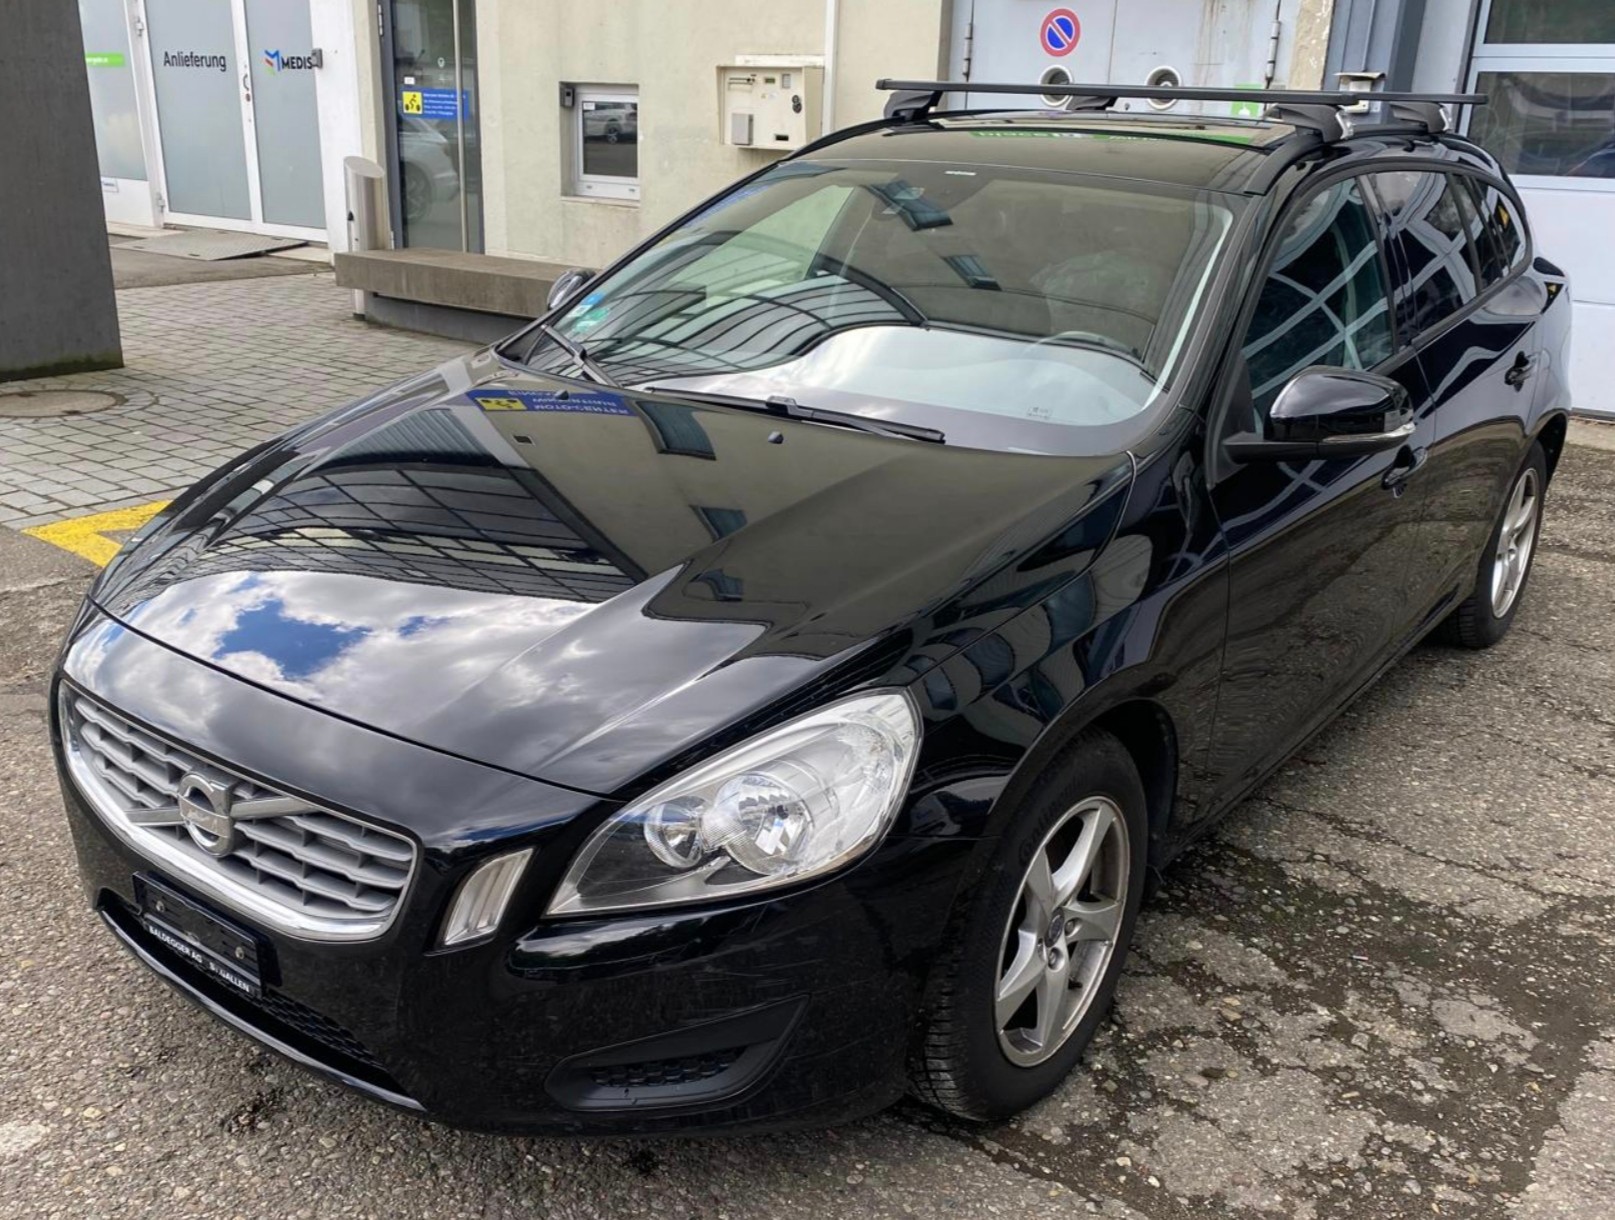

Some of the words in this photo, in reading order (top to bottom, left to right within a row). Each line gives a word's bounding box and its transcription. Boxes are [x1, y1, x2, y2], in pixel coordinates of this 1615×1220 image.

[163, 51, 227, 72] Anlieferung
[149, 926, 191, 955] BALDEGGER
[191, 950, 203, 963] AG
[221, 971, 250, 992] GALLEN
